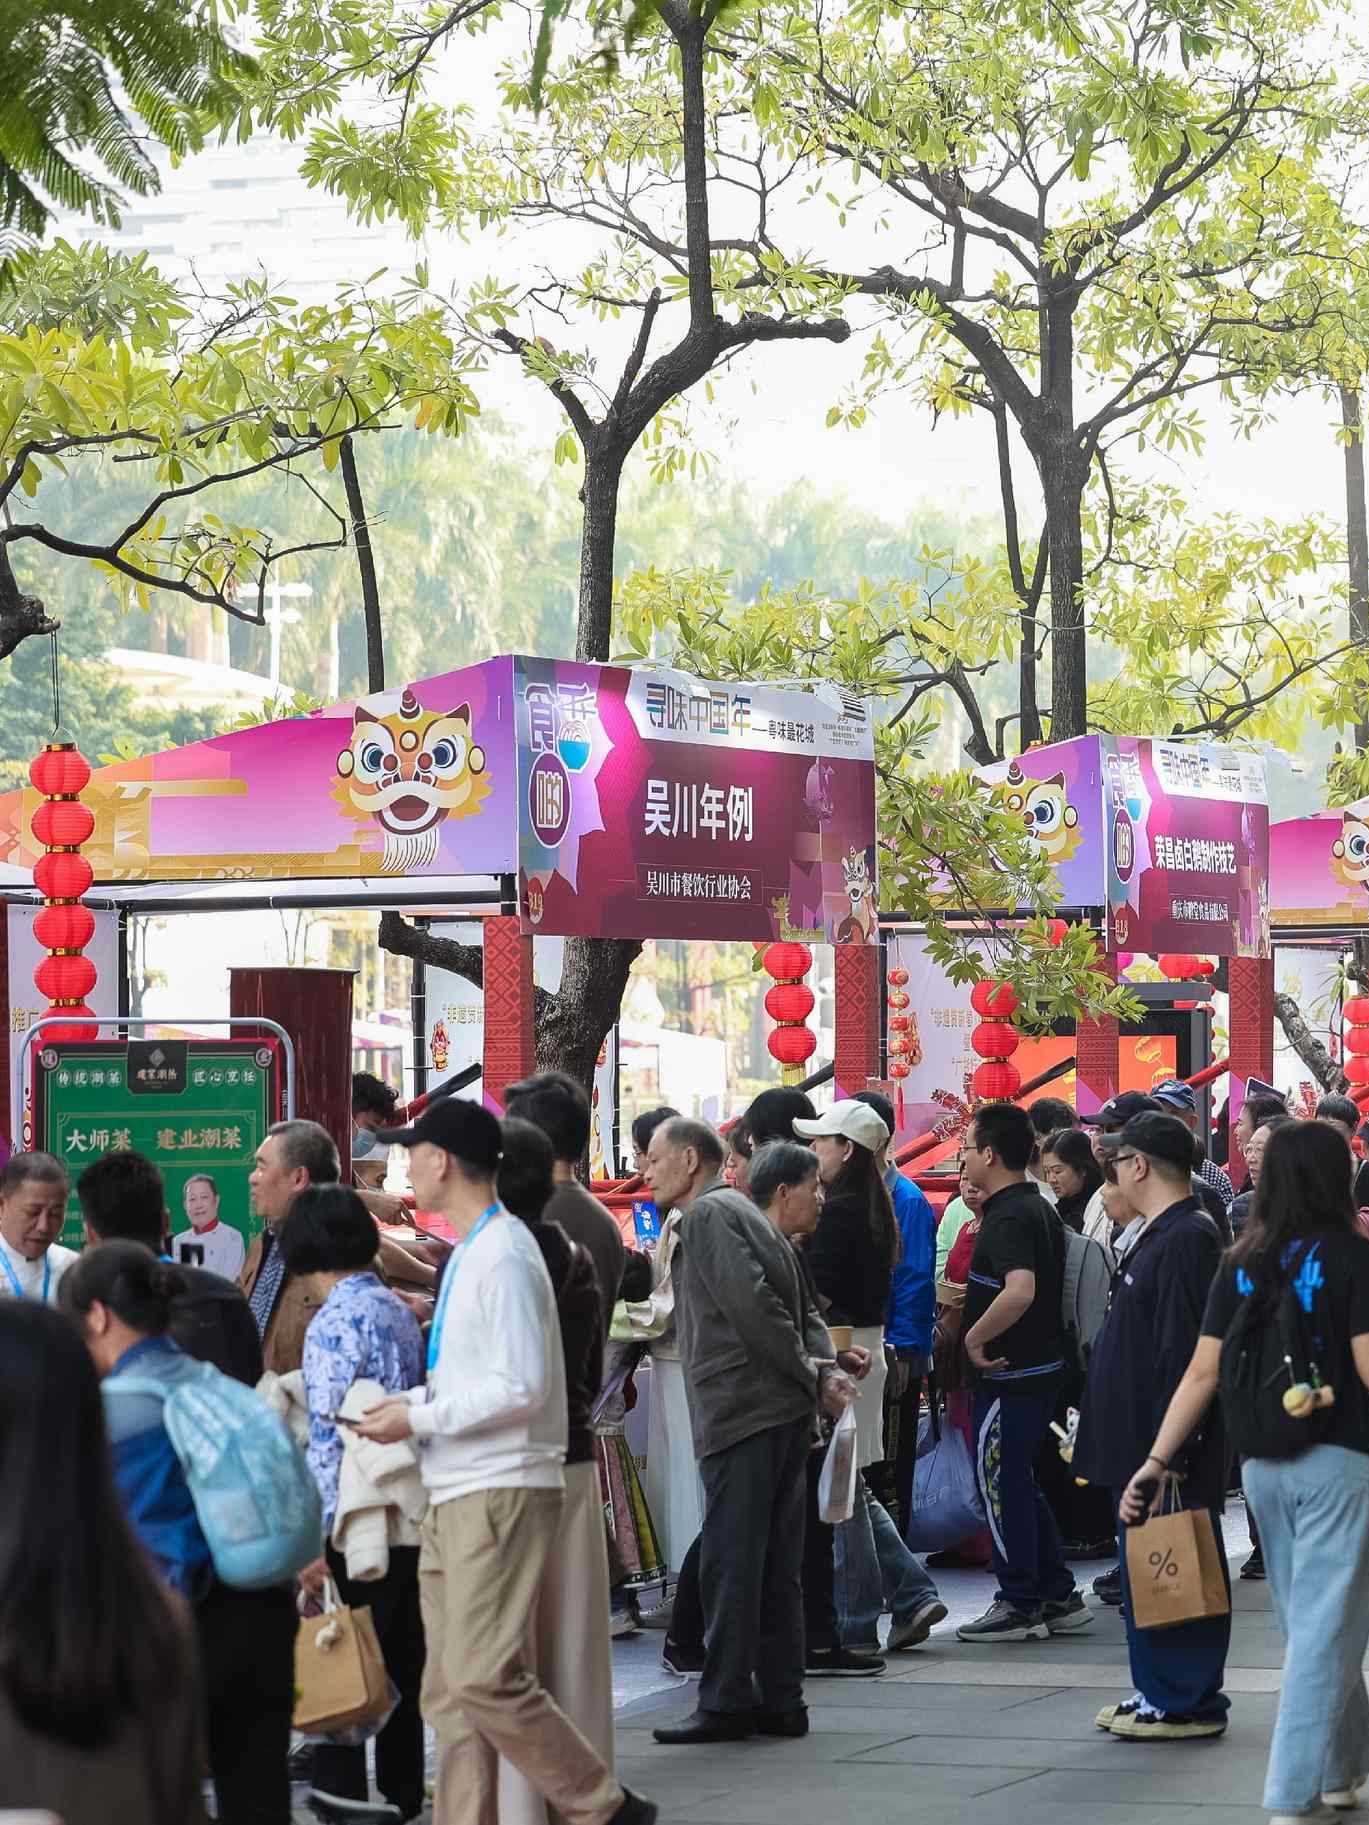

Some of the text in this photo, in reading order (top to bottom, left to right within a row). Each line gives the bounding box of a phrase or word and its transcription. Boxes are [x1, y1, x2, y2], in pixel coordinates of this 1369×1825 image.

[646, 682, 751, 736] 寻味中国年
[644, 779, 753, 842] 吴川年例
[1154, 834, 1237, 874] 荣昌卤白鹅制作技艺
[646, 870, 752, 900] 吴川市餐饮行业协会
[66, 1125, 243, 1153] 大师菜 建业潮菜
